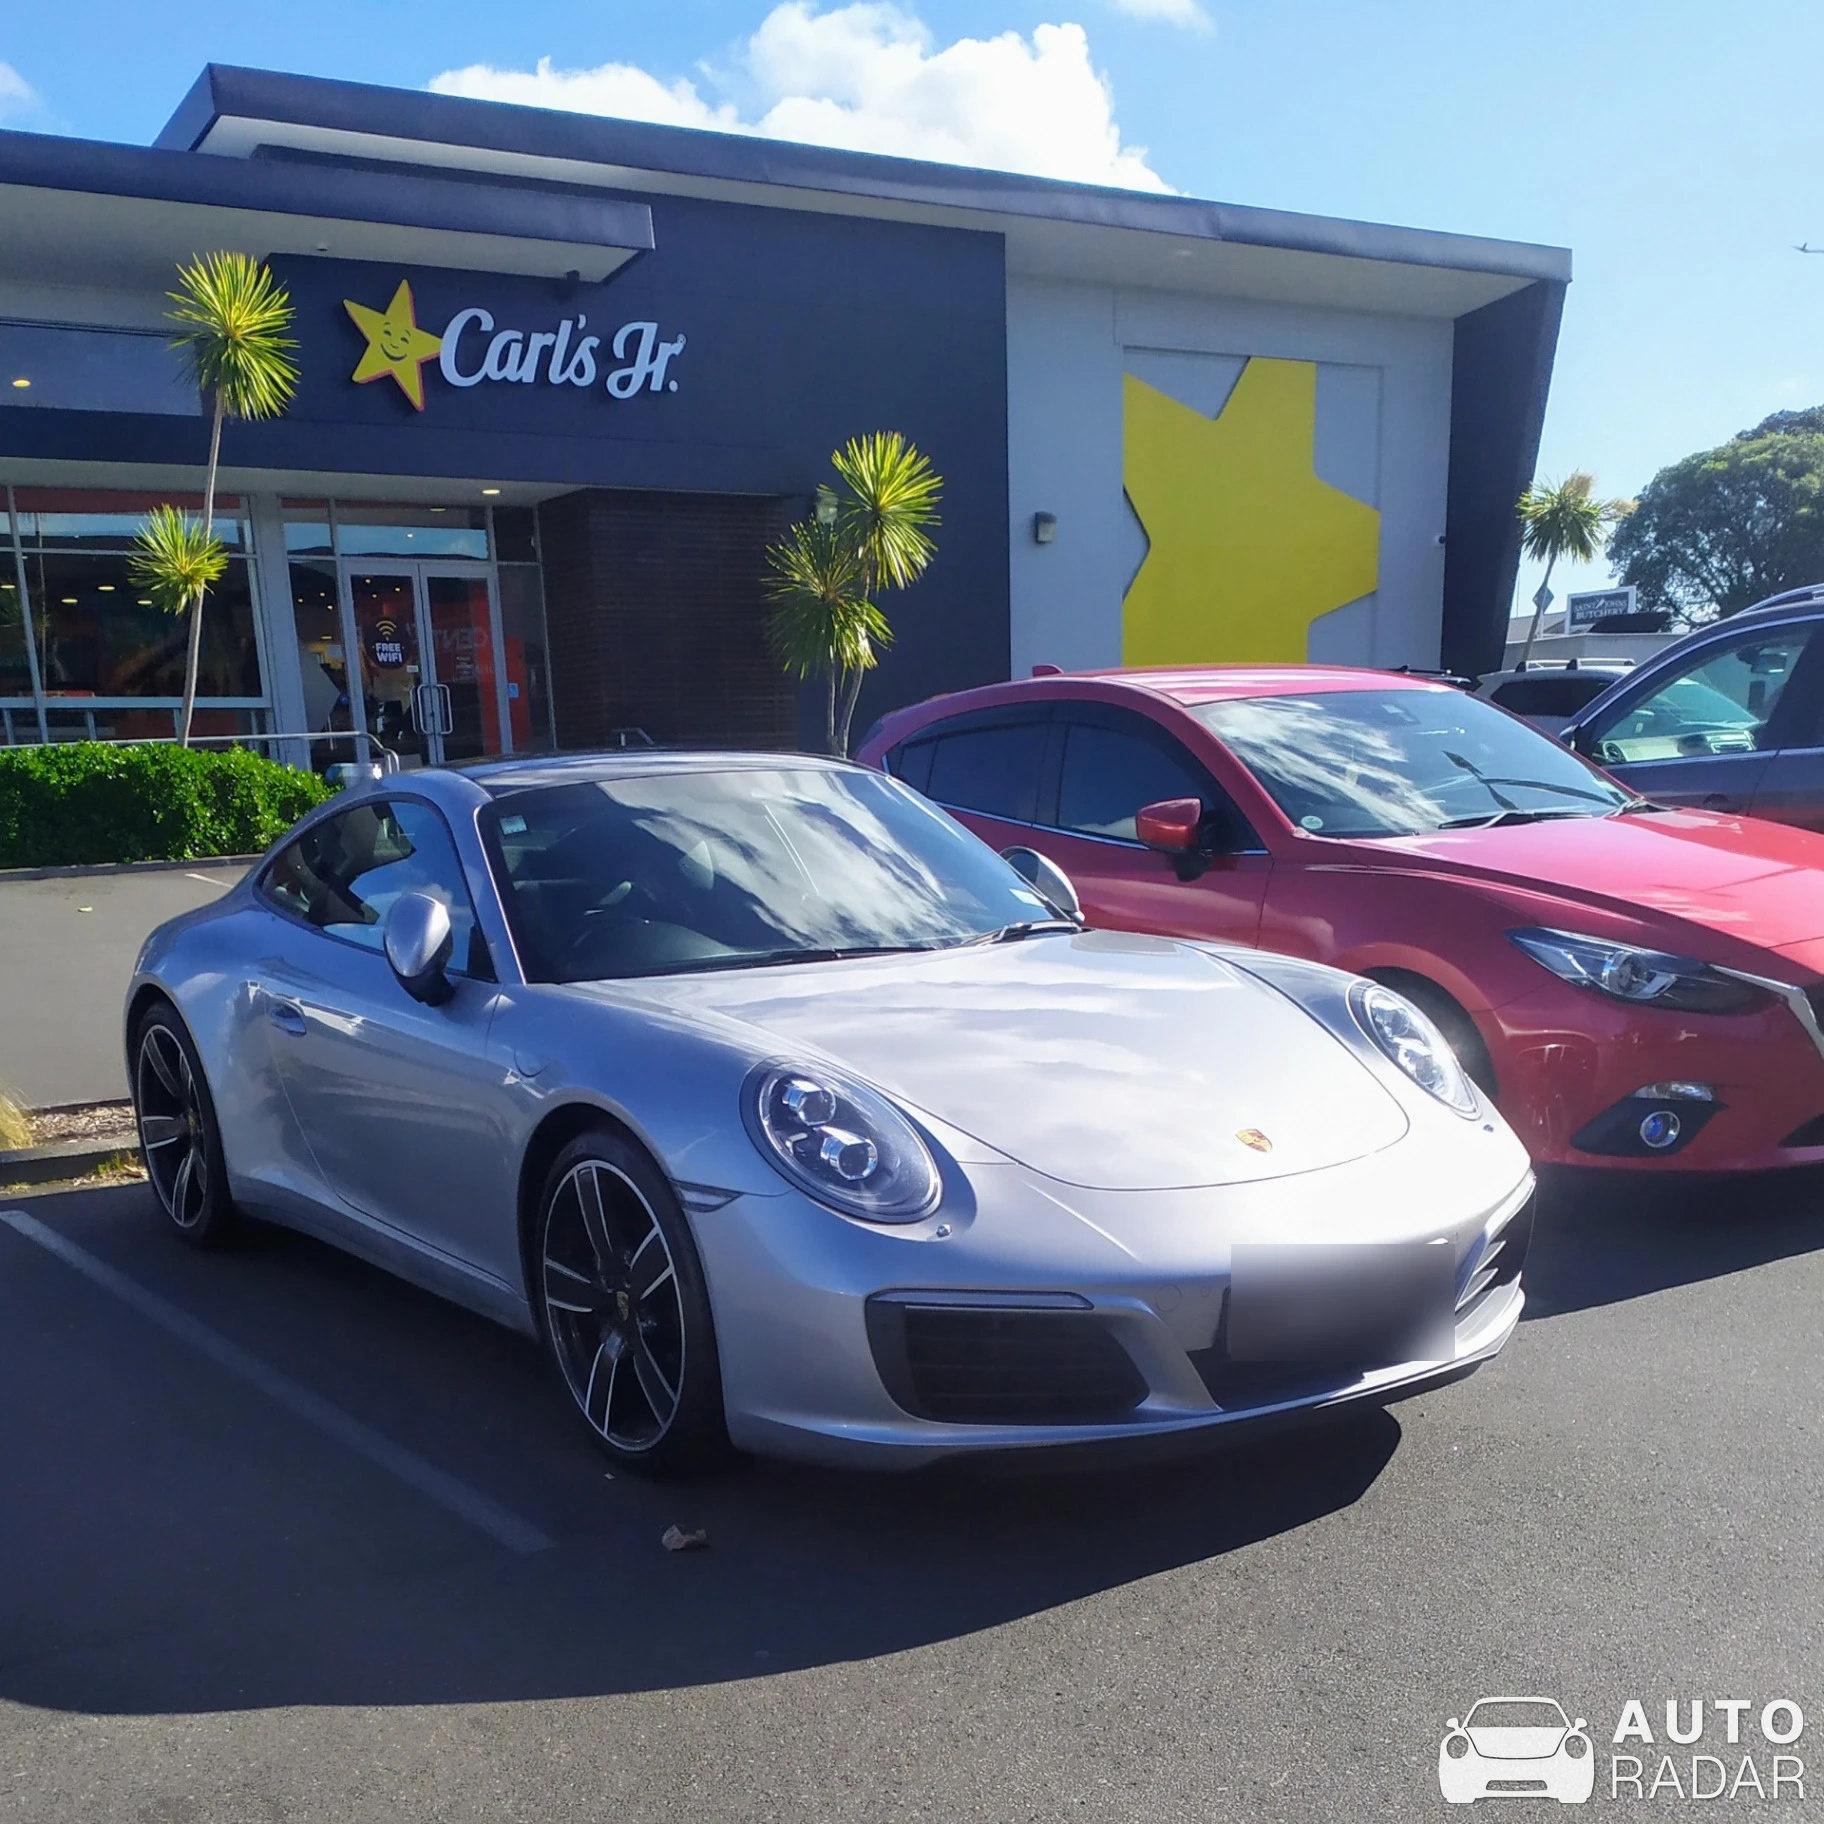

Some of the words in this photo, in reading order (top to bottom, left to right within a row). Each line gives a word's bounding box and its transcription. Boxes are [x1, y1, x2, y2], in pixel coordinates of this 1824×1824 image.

[440, 308, 600, 387] Carl's
[606, 321, 686, 399] Jr.
[1574, 602, 1598, 612] SAINT
[1576, 608, 1623, 620] BUTCHERY
[376, 642, 401, 652] FREE
[377, 652, 402, 663] WIFI
